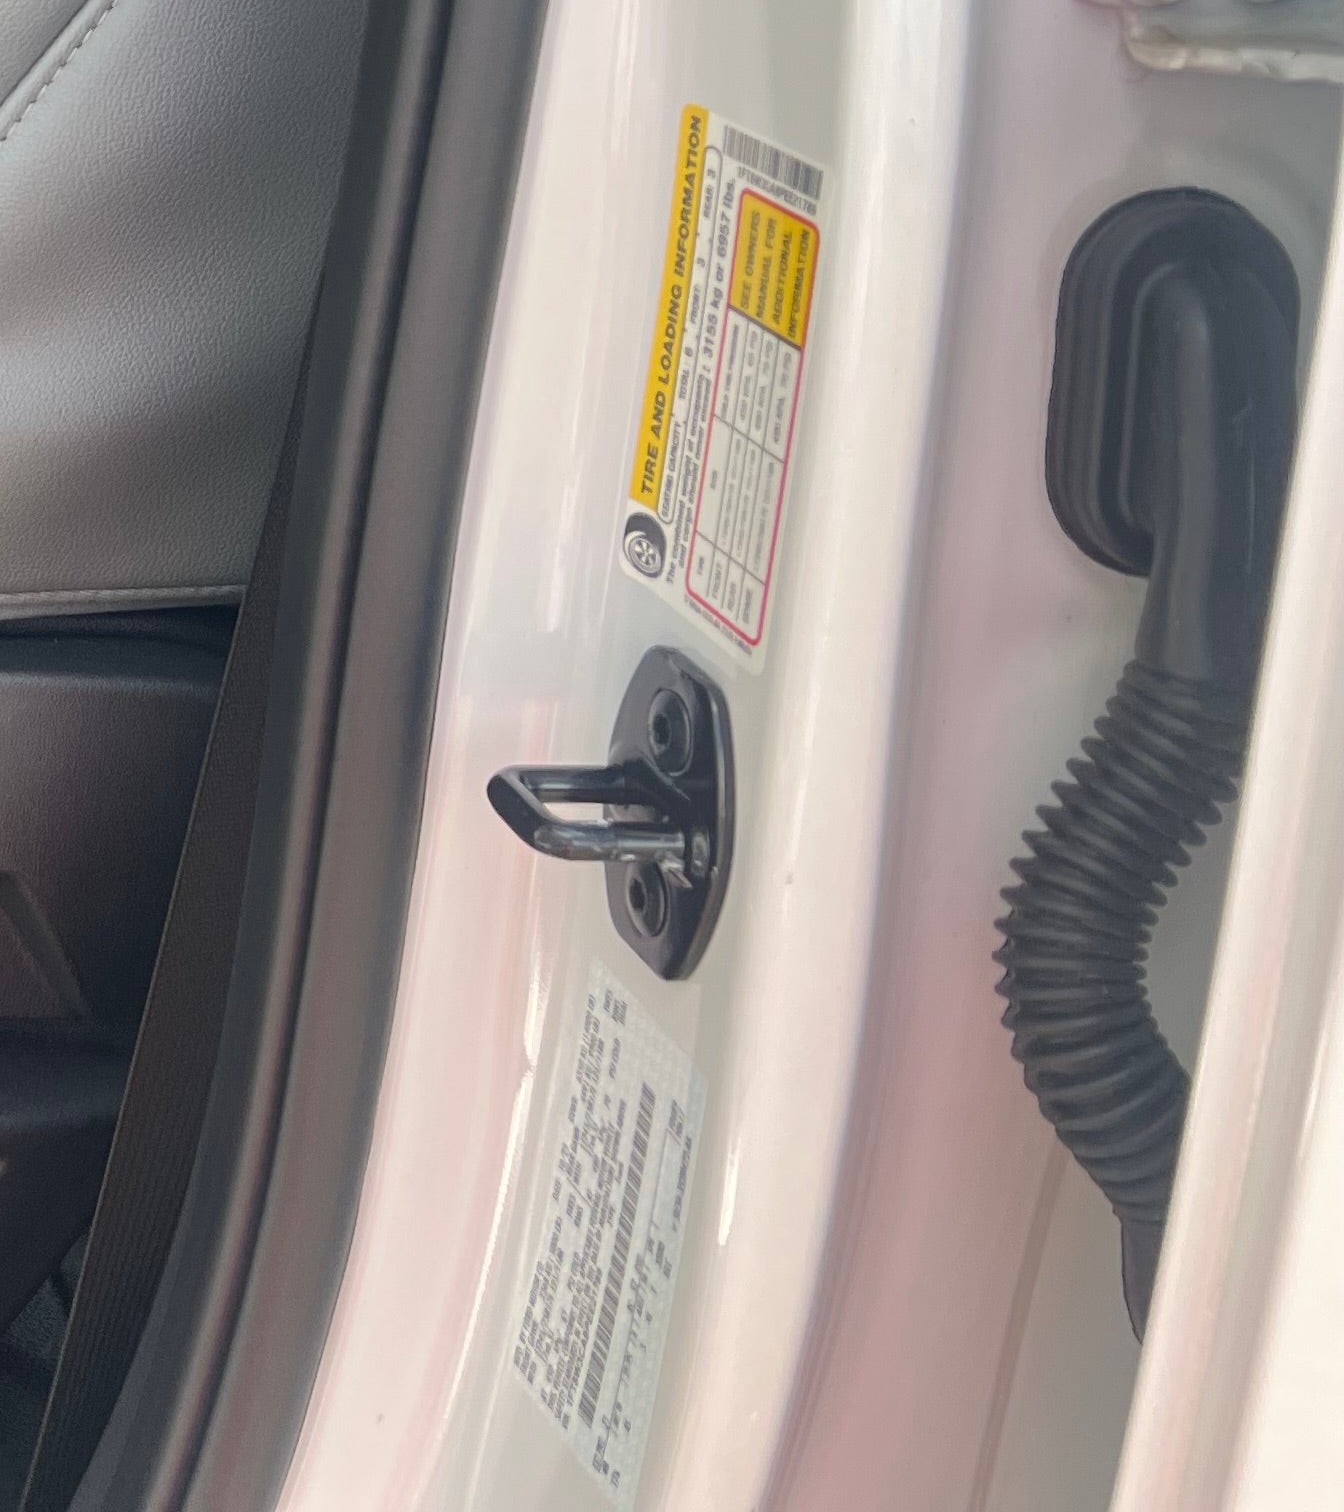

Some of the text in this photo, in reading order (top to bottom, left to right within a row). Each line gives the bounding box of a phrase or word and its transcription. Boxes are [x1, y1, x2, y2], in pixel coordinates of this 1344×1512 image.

[715, 211, 731, 259] 6957
[739, 208, 761, 310] SEE OWNERS
[770, 228, 792, 325] ADDITIONAL
[786, 228, 810, 339] INFORMATION
[640, 113, 701, 500] TIRE AND LOADING INFORMATION
[708, 284, 723, 311] kg
[754, 254, 772, 320] MANUAL
